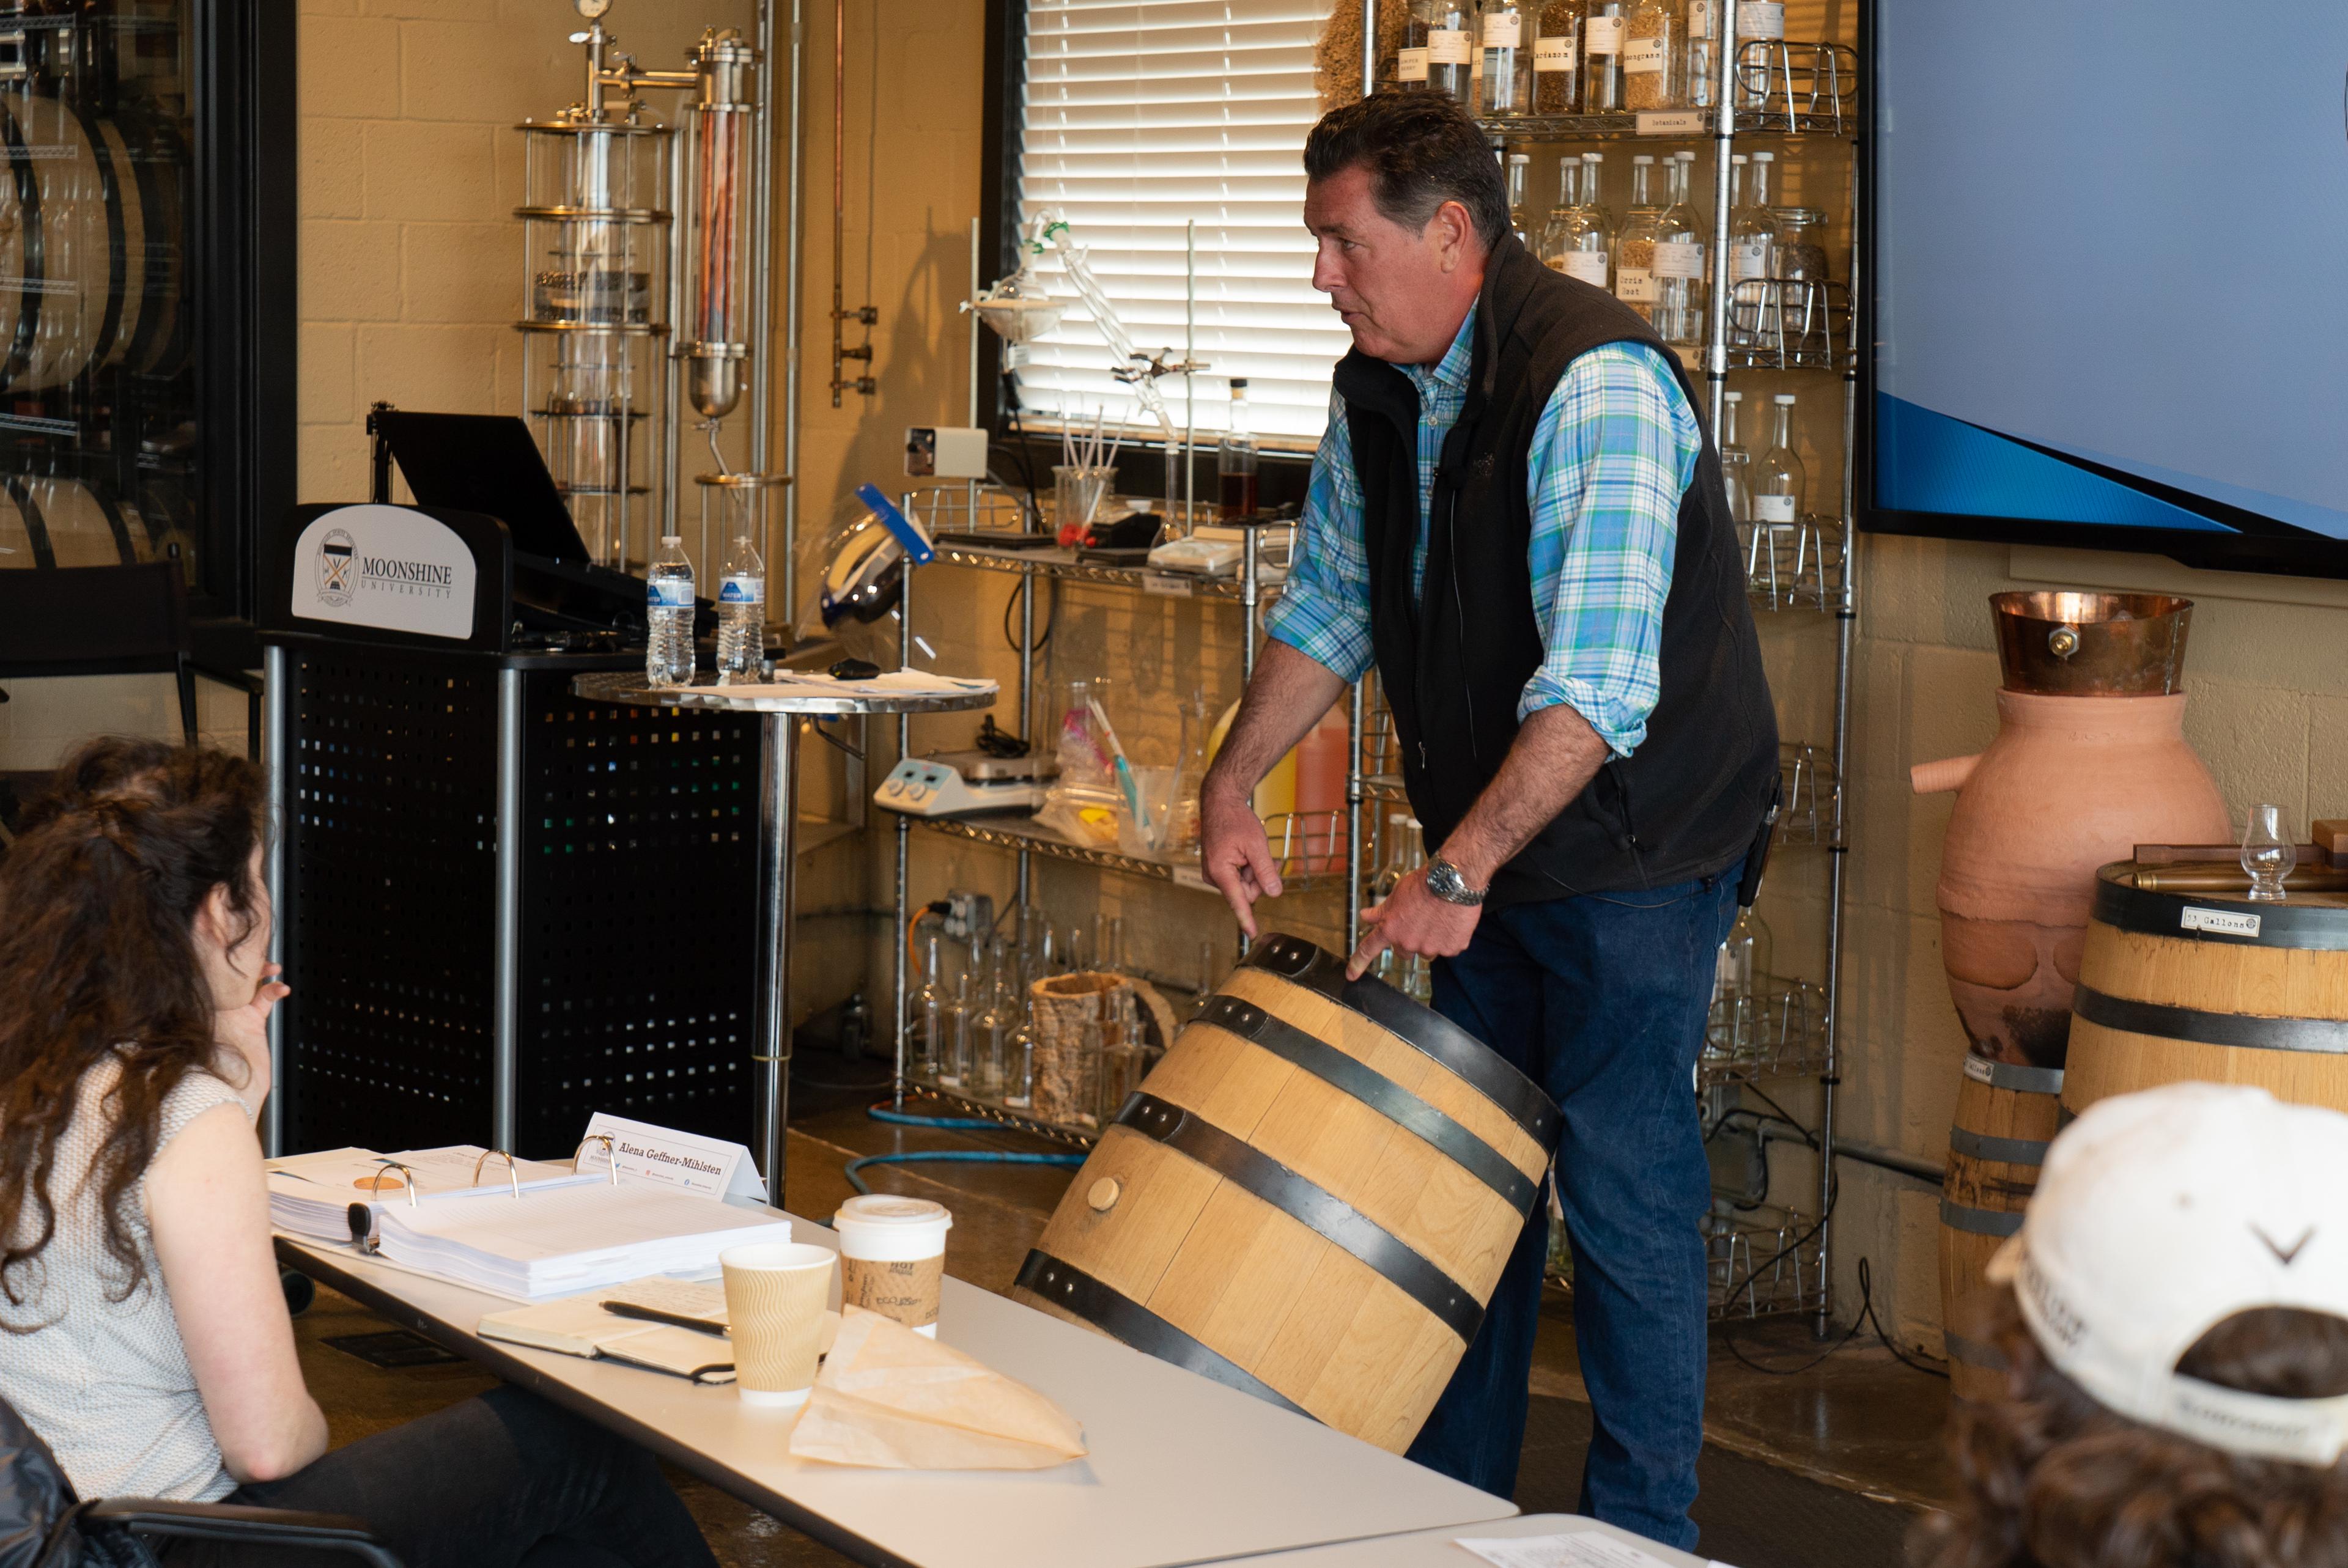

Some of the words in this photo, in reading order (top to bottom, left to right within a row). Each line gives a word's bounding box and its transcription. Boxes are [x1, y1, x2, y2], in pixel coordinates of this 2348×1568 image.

[361, 556, 452, 585] MOONSHINE
[361, 580, 451, 599] UNIVERSITY
[2204, 916, 2245, 929] Gallons
[619, 1142, 644, 1157] Alena
[646, 1149, 722, 1176] Geffner-Mihlsten
